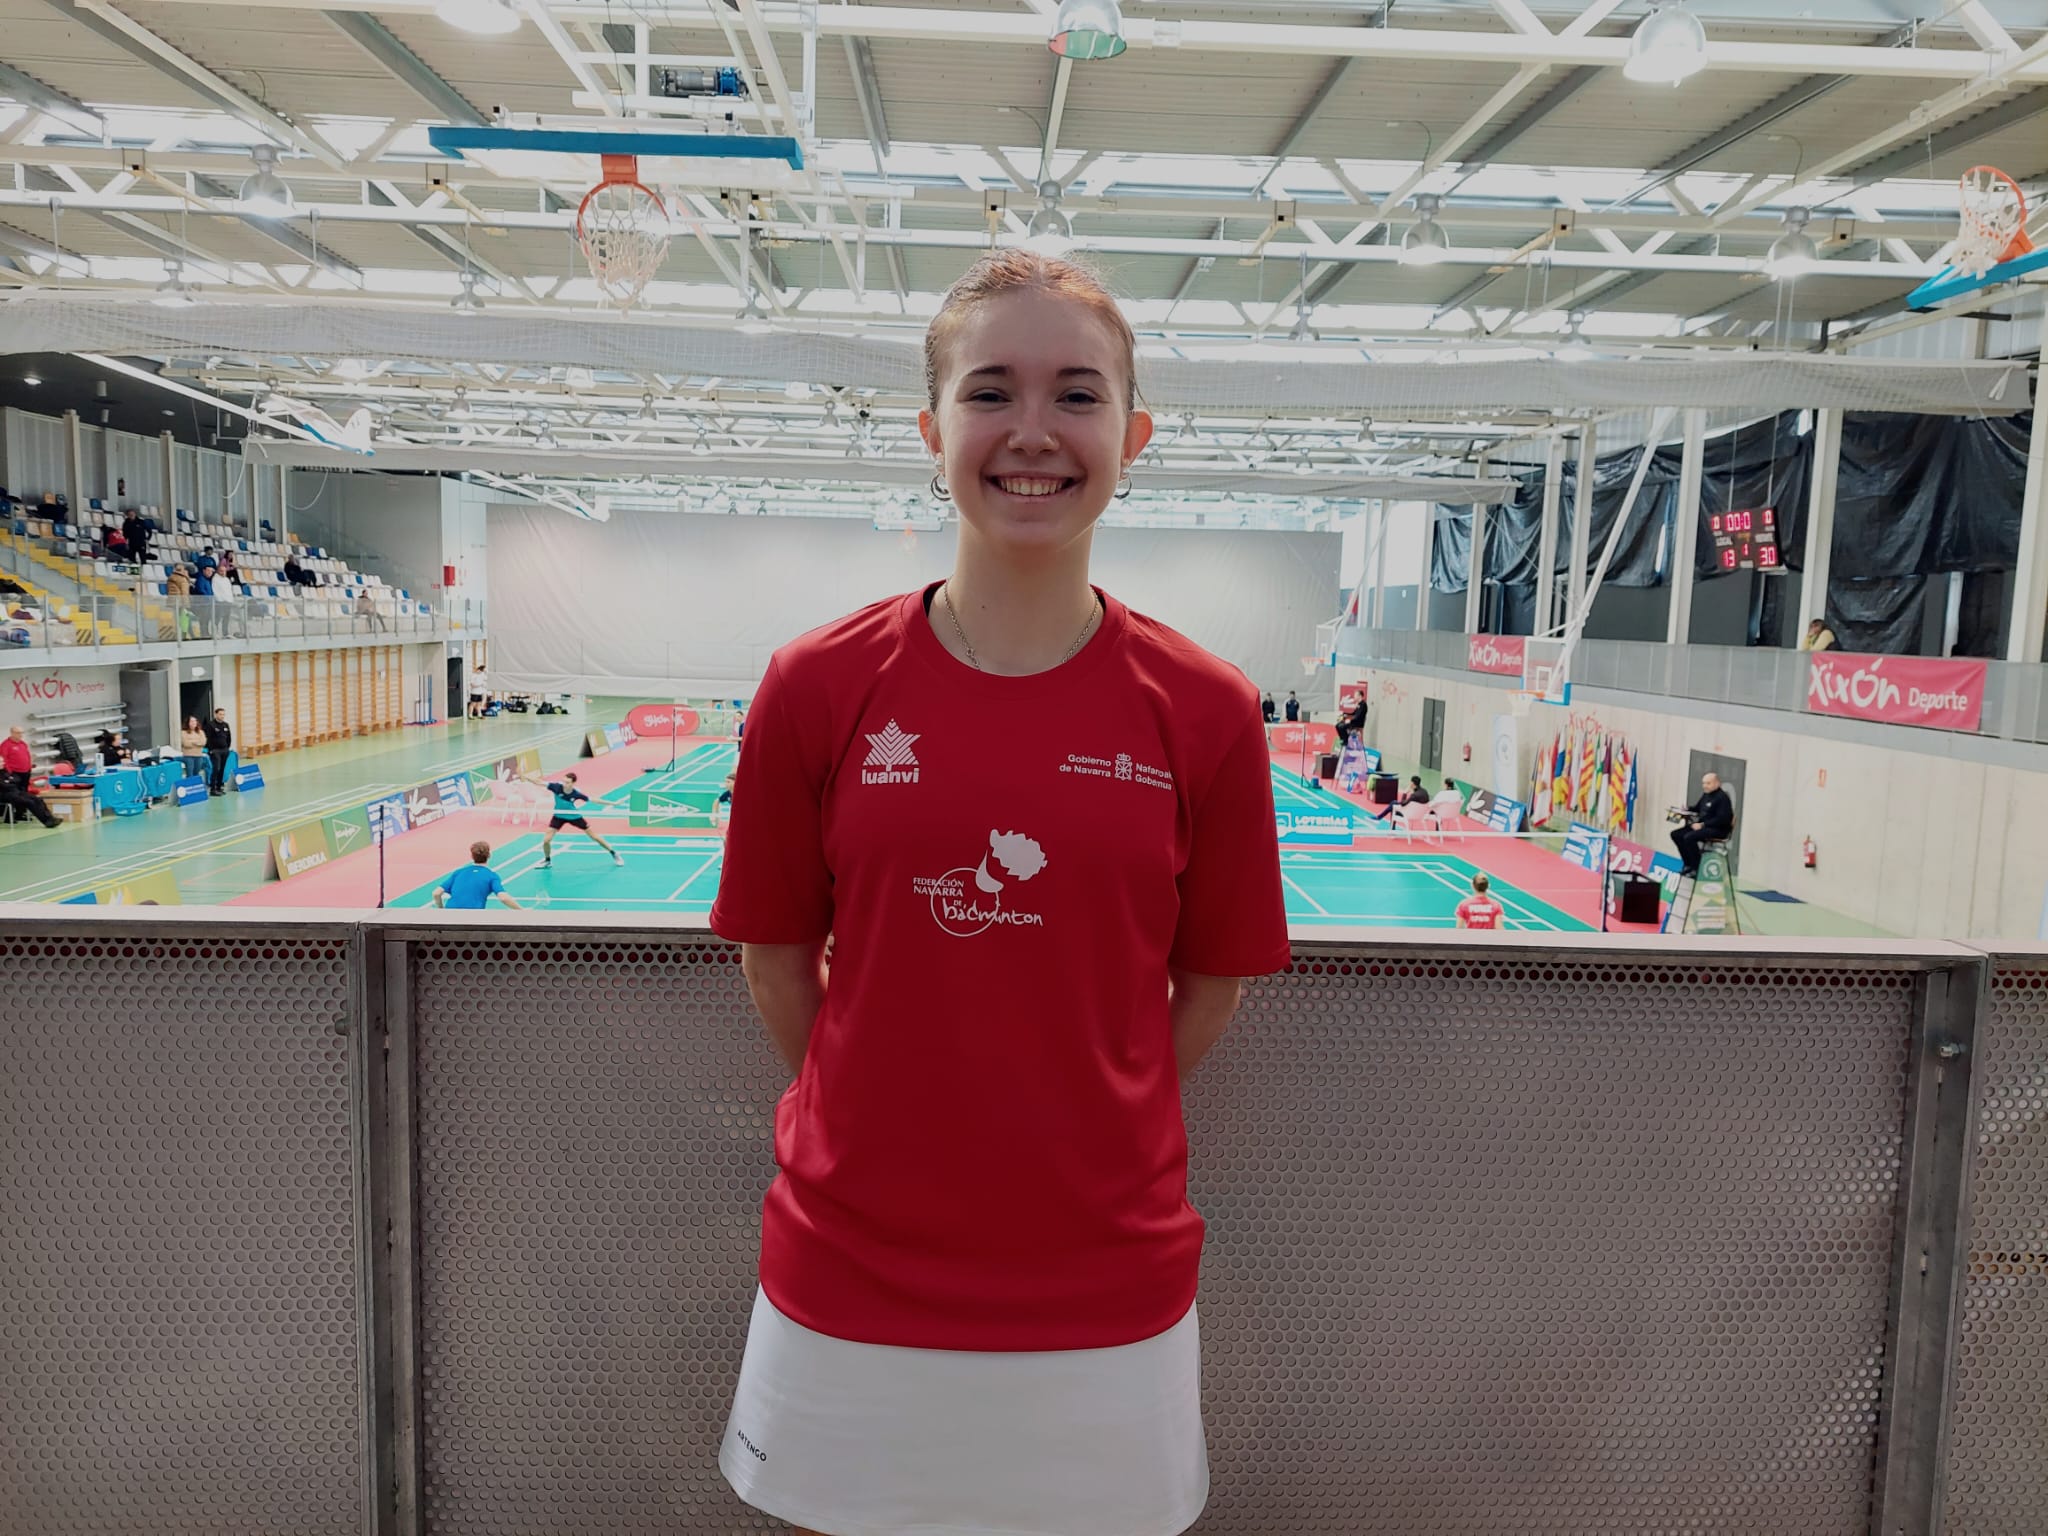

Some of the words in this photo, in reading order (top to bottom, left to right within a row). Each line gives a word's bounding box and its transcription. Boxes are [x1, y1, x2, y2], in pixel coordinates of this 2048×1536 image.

[1722, 549, 1736, 567] 13
[1760, 546, 1776, 566] 30
[1908, 688, 1968, 714] Deporte
[1068, 754, 1111, 767] Gobierno
[861, 768, 919, 784] luanvi
[1059, 764, 1072, 773] de
[1074, 765, 1111, 778] Navarra
[913, 877, 964, 888] FEDERACIÓN
[913, 885, 964, 897] NAVARRA
